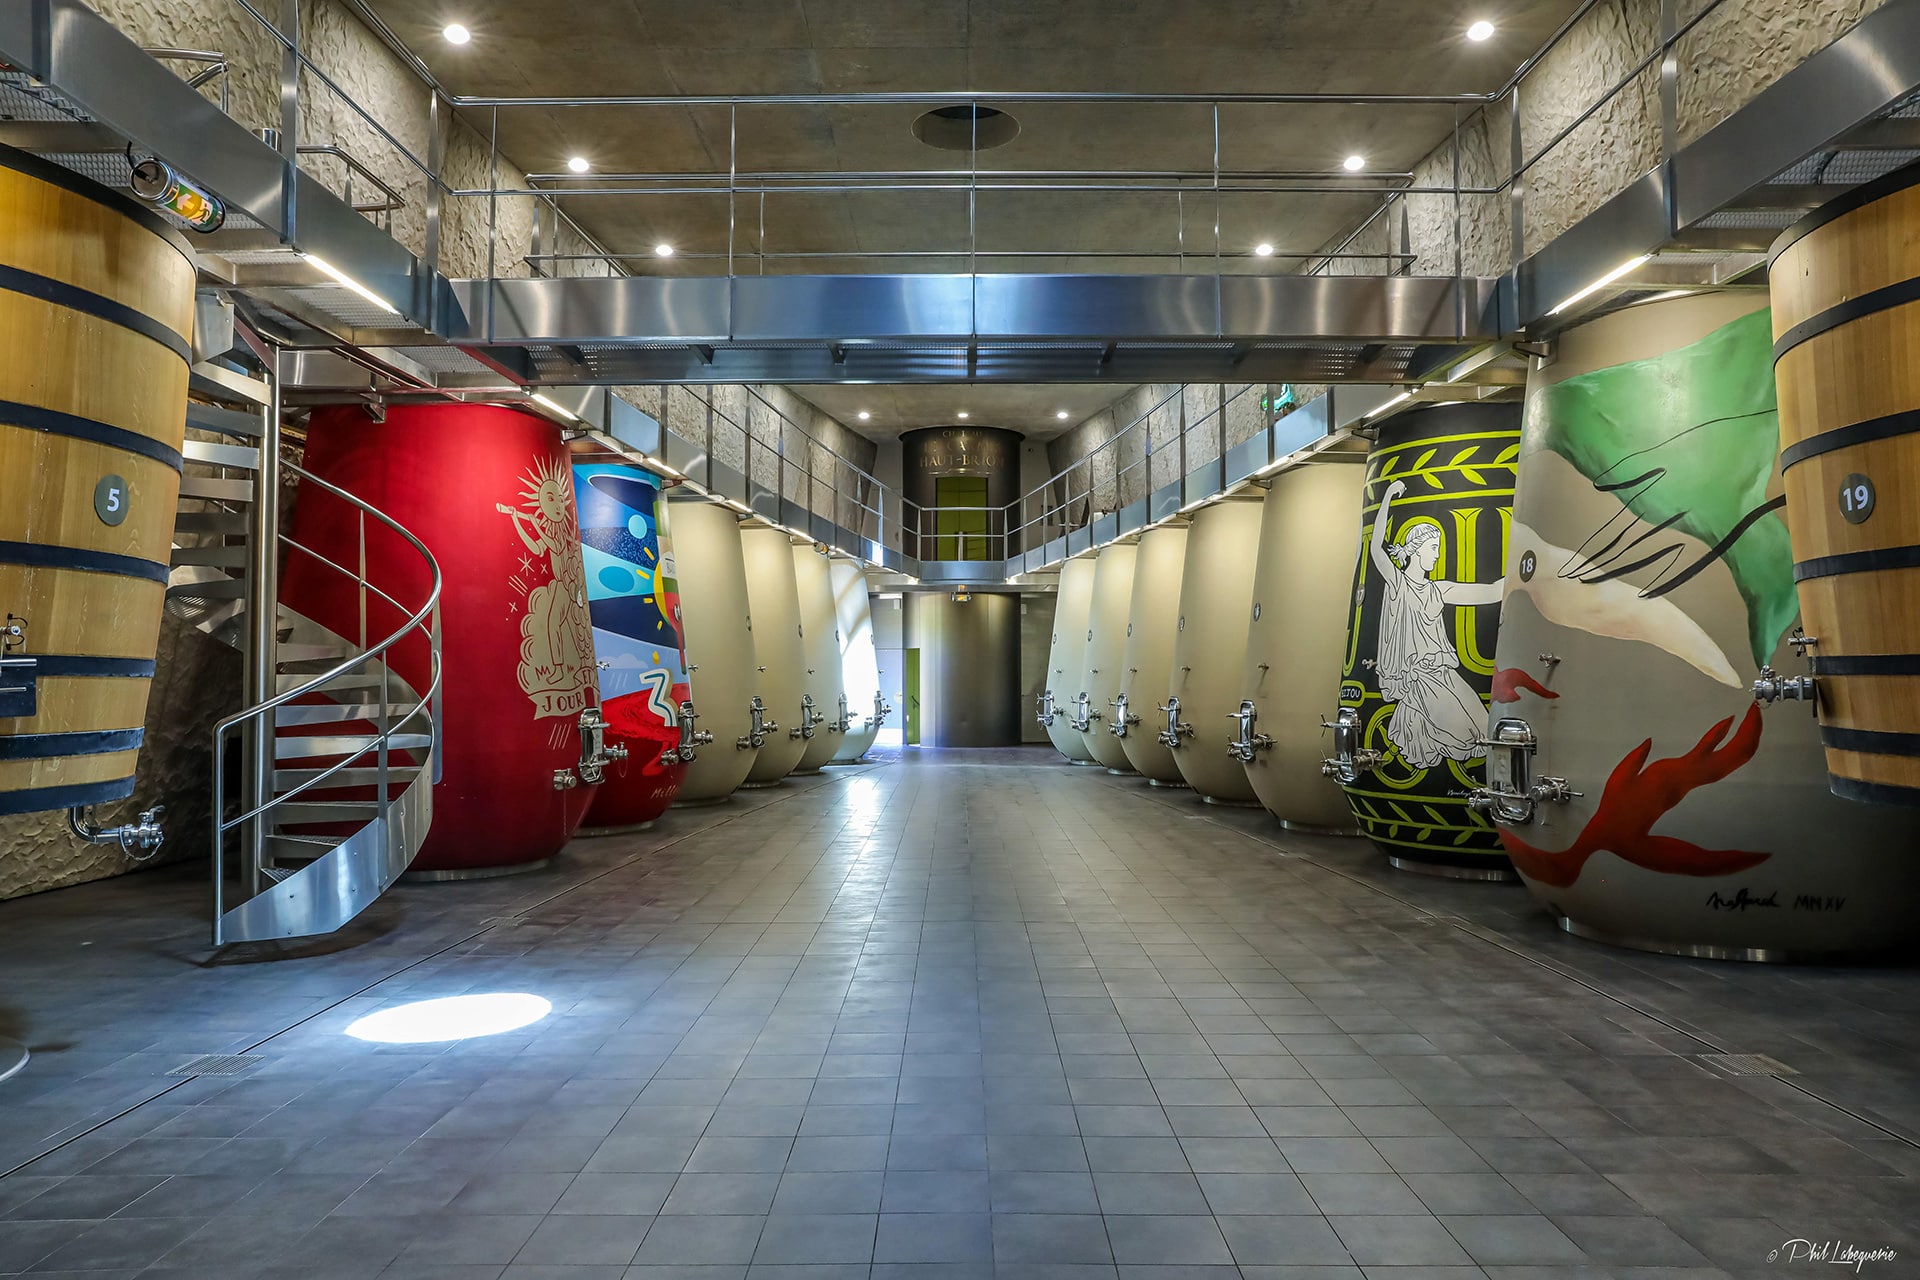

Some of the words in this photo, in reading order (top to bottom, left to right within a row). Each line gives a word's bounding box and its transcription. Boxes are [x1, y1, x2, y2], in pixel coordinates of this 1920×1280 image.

[106, 487, 120, 512] 5
[1842, 485, 1869, 512] 19
[1521, 557, 1534, 574] 18
[541, 691, 585, 713] JOUR
